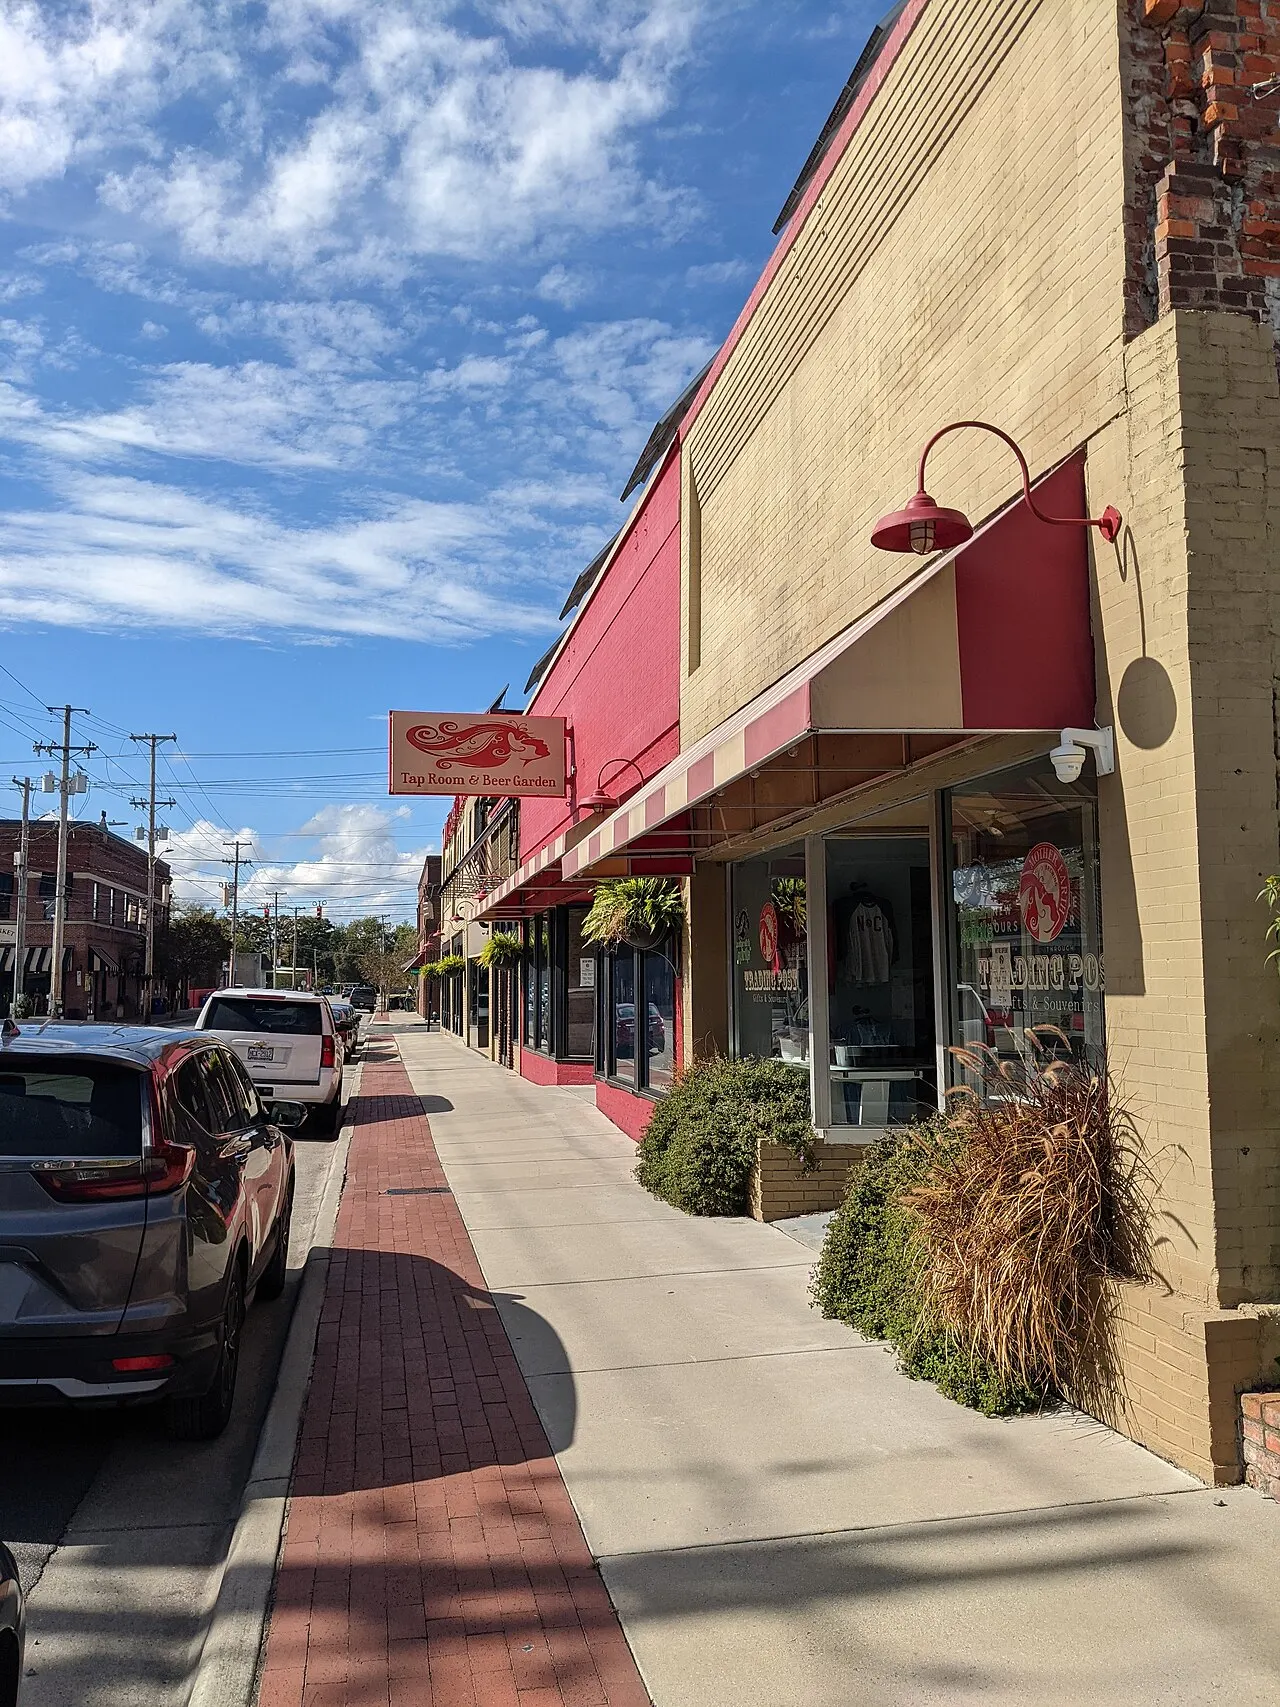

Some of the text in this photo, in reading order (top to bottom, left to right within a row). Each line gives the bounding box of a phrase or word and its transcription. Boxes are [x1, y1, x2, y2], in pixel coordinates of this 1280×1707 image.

[401, 772, 557, 788] Tap Room & Beer Garden
[1028, 847, 1059, 869] MOTHER
[744, 969, 798, 990] TRADING POST
[1033, 996, 1040, 1010] &
[1043, 996, 1100, 1012] Souvenirs
